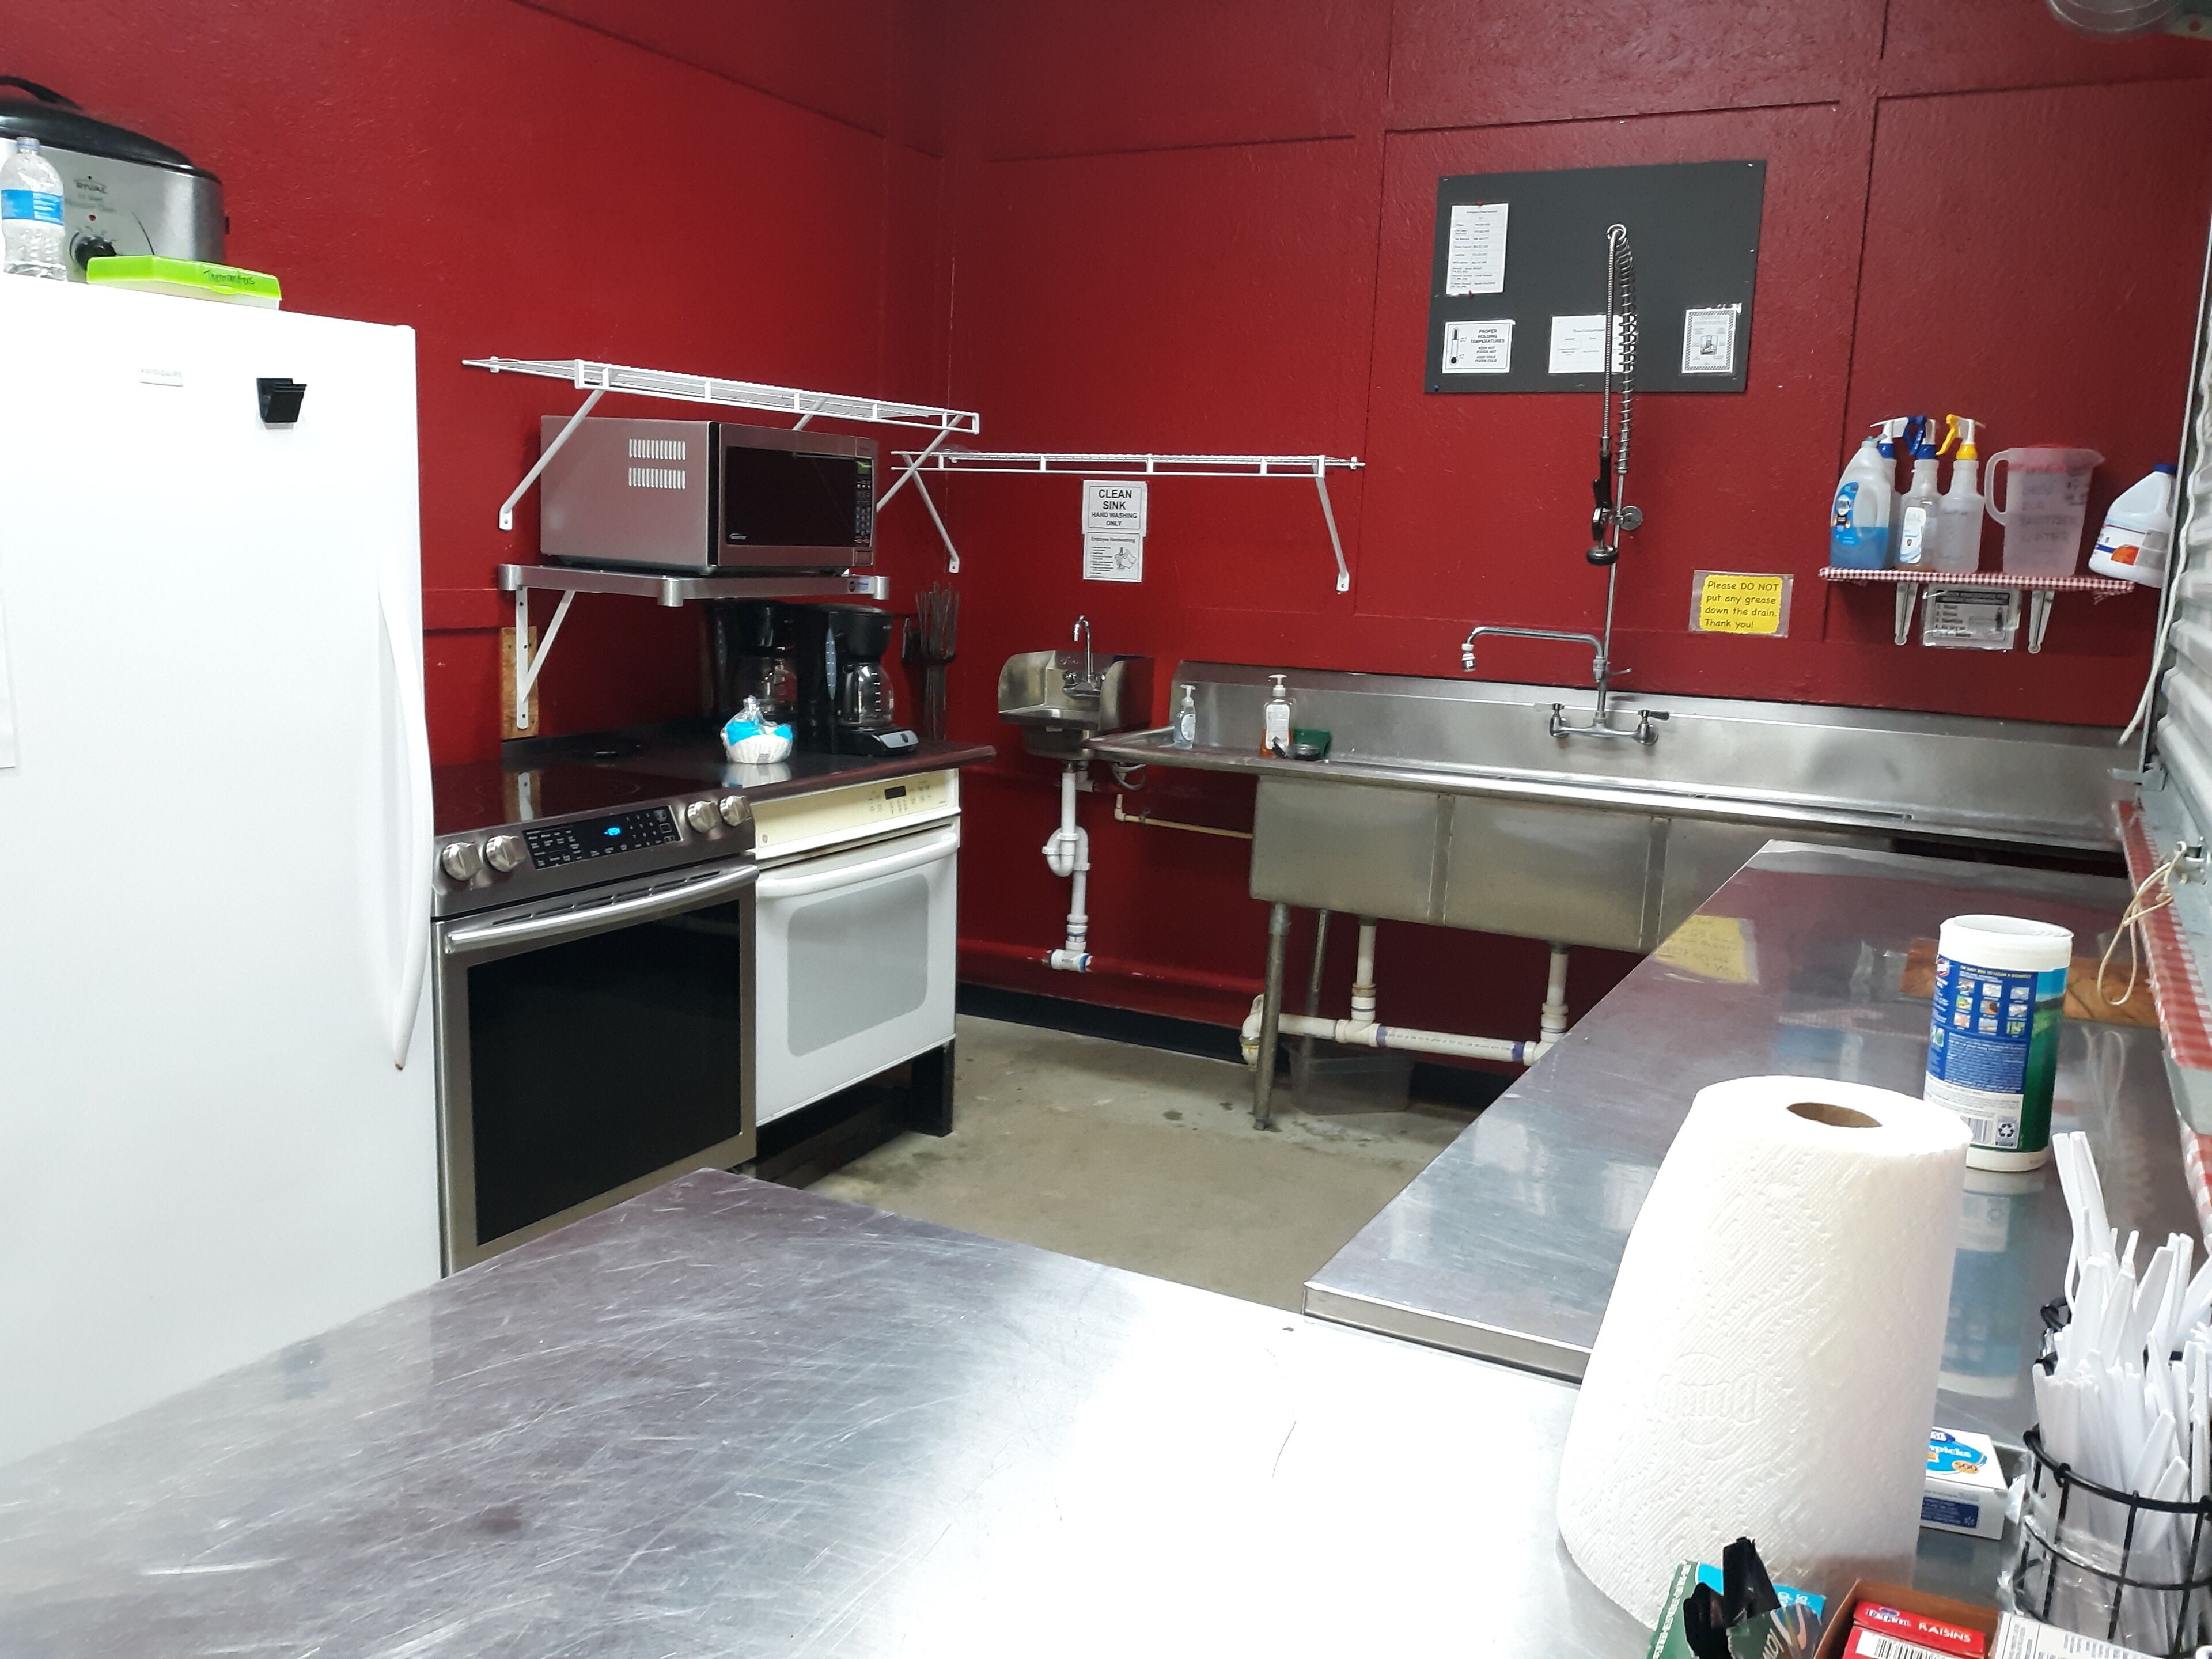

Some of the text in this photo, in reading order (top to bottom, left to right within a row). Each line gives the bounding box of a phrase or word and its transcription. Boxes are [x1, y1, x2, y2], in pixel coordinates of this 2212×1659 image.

[1099, 489, 1132, 498] CLEAN
[1103, 501, 1127, 510] SINK
[1707, 581, 1779, 591] Please DO NOT
[1706, 594, 1776, 605] put any grease
[1705, 606, 1777, 617] down the drain.
[1705, 618, 1754, 630] Thank you!
[1918, 1622, 1971, 1643] RAISINS
